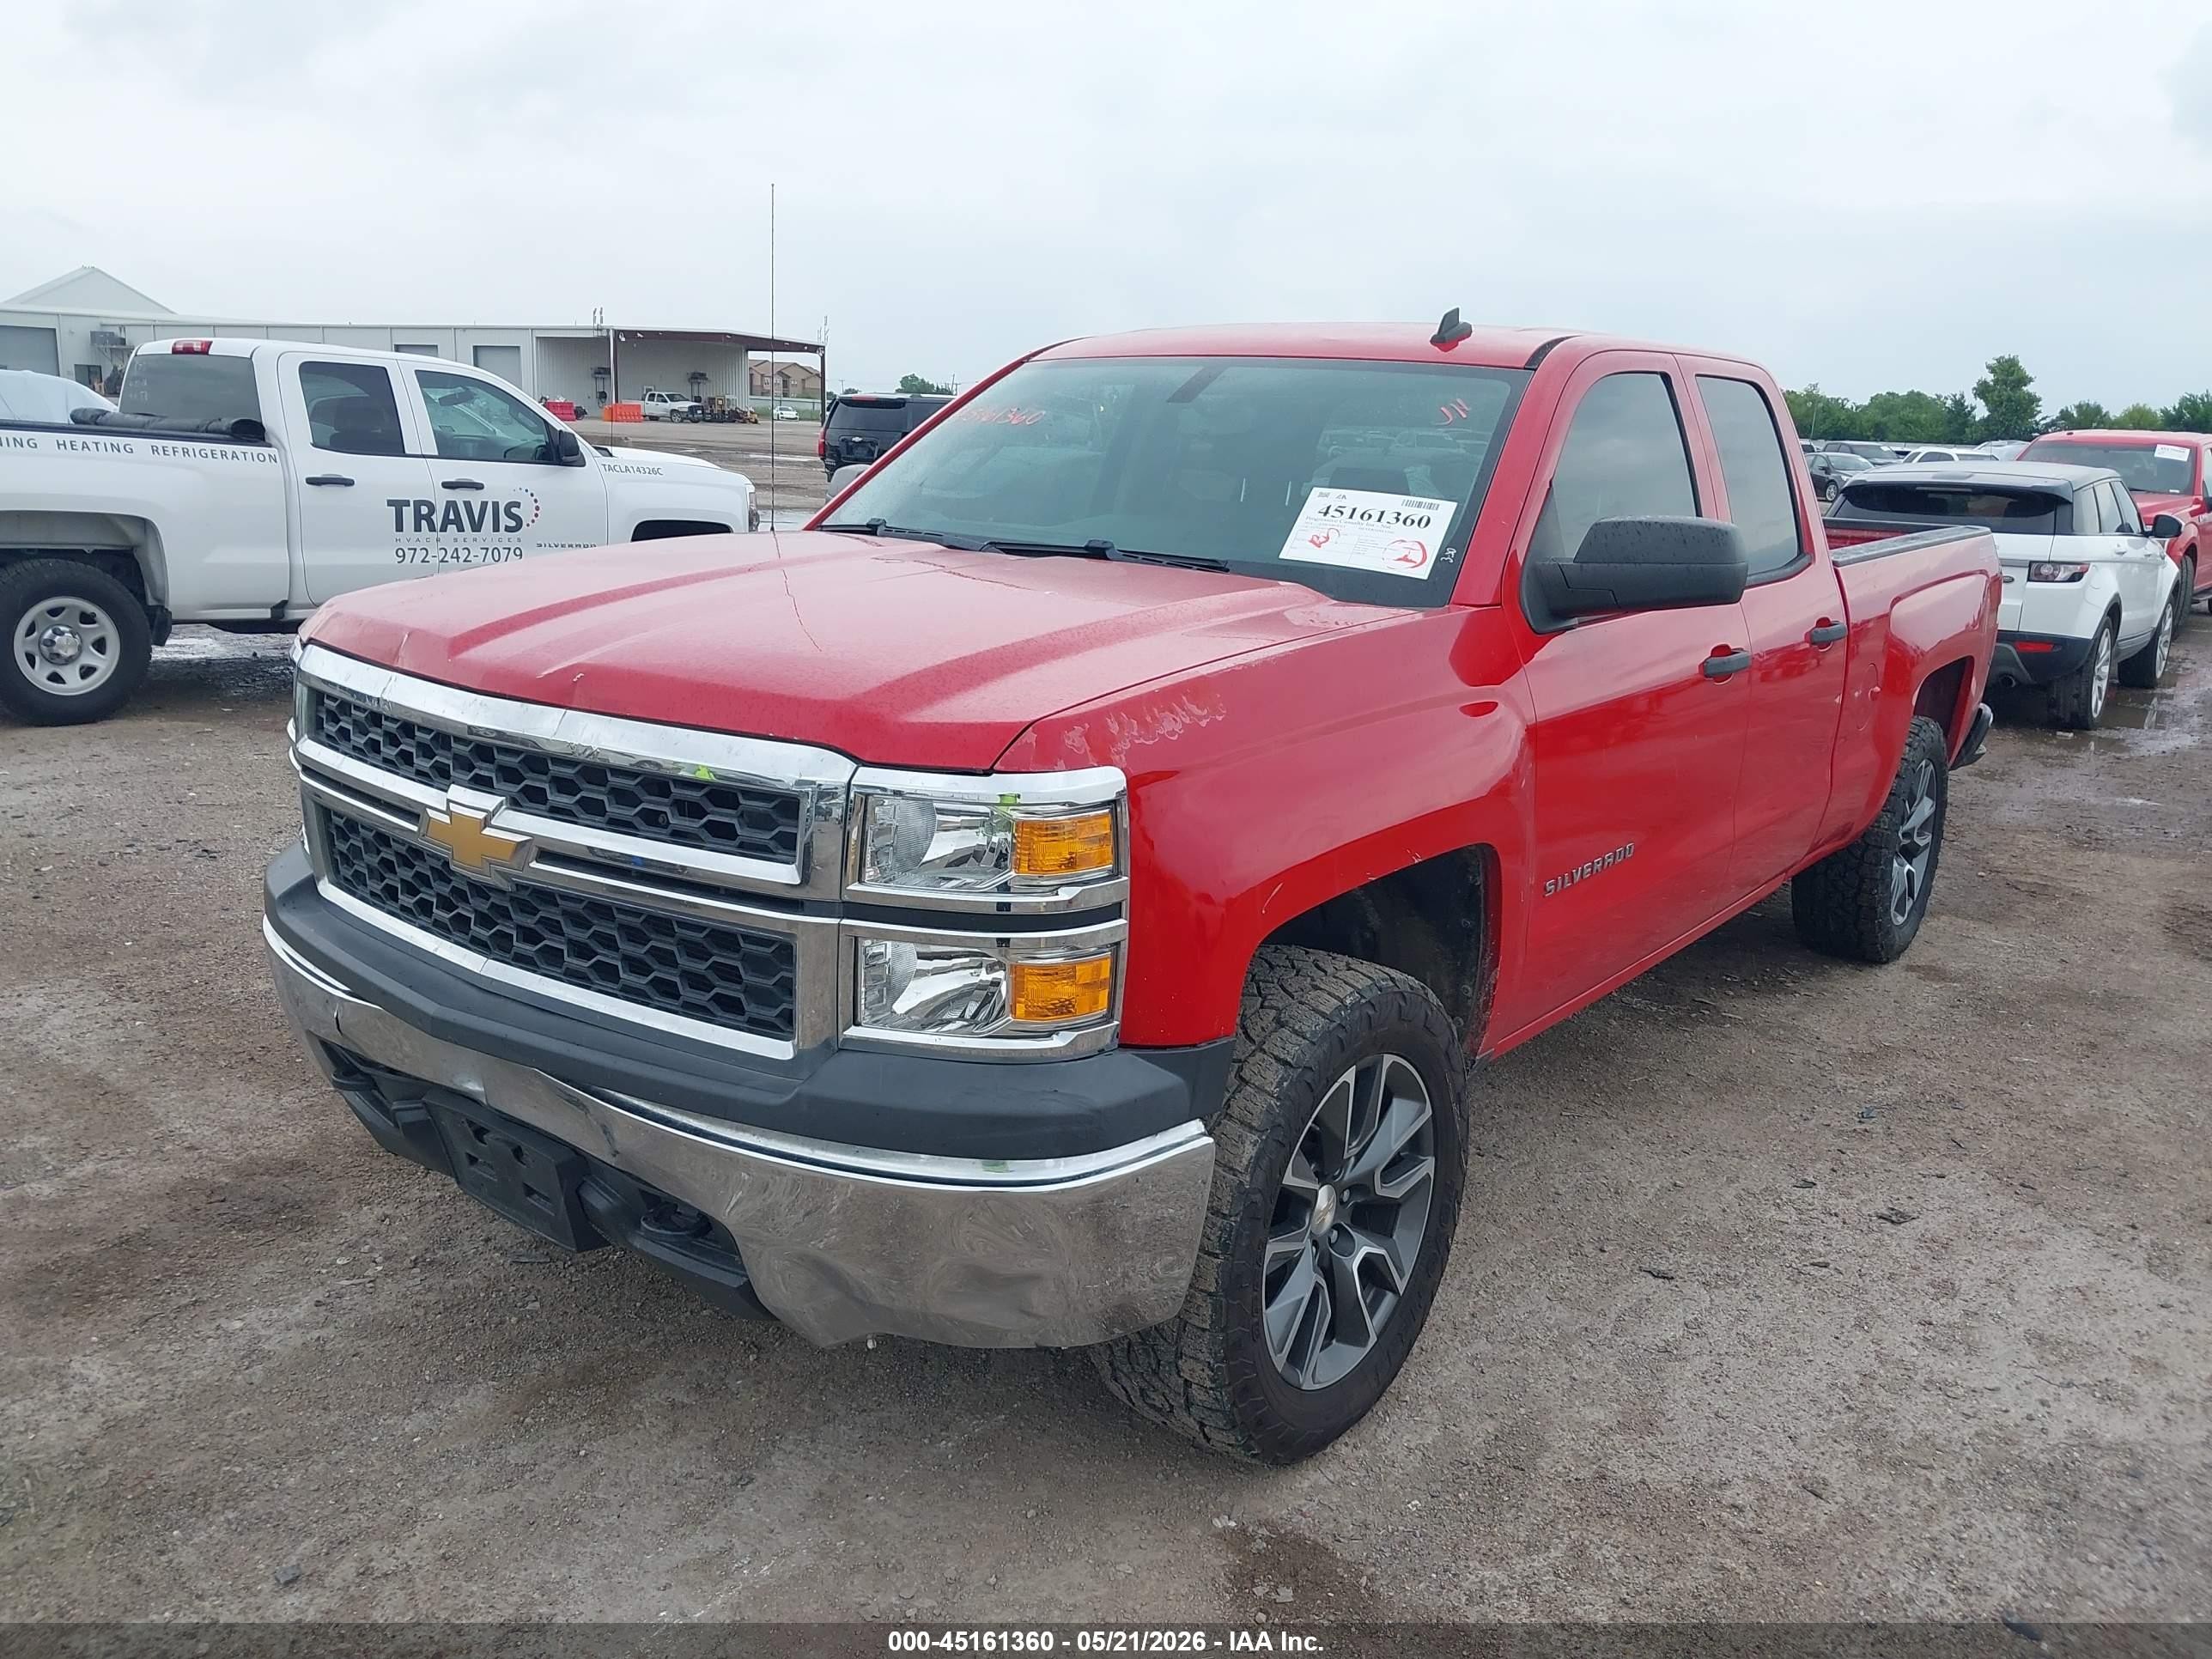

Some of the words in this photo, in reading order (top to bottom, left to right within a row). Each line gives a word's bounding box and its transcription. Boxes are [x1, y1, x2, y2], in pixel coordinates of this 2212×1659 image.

[56, 439, 134, 454] HEATING
[151, 445, 278, 464] REFRIGERATION
[601, 464, 664, 476] TACLA14326C
[386, 499, 524, 532] TRAVIS
[1317, 503, 1431, 529] 45161360
[395, 546, 523, 564] 972-242-7079
[1544, 842, 1635, 897] SILVERADO
